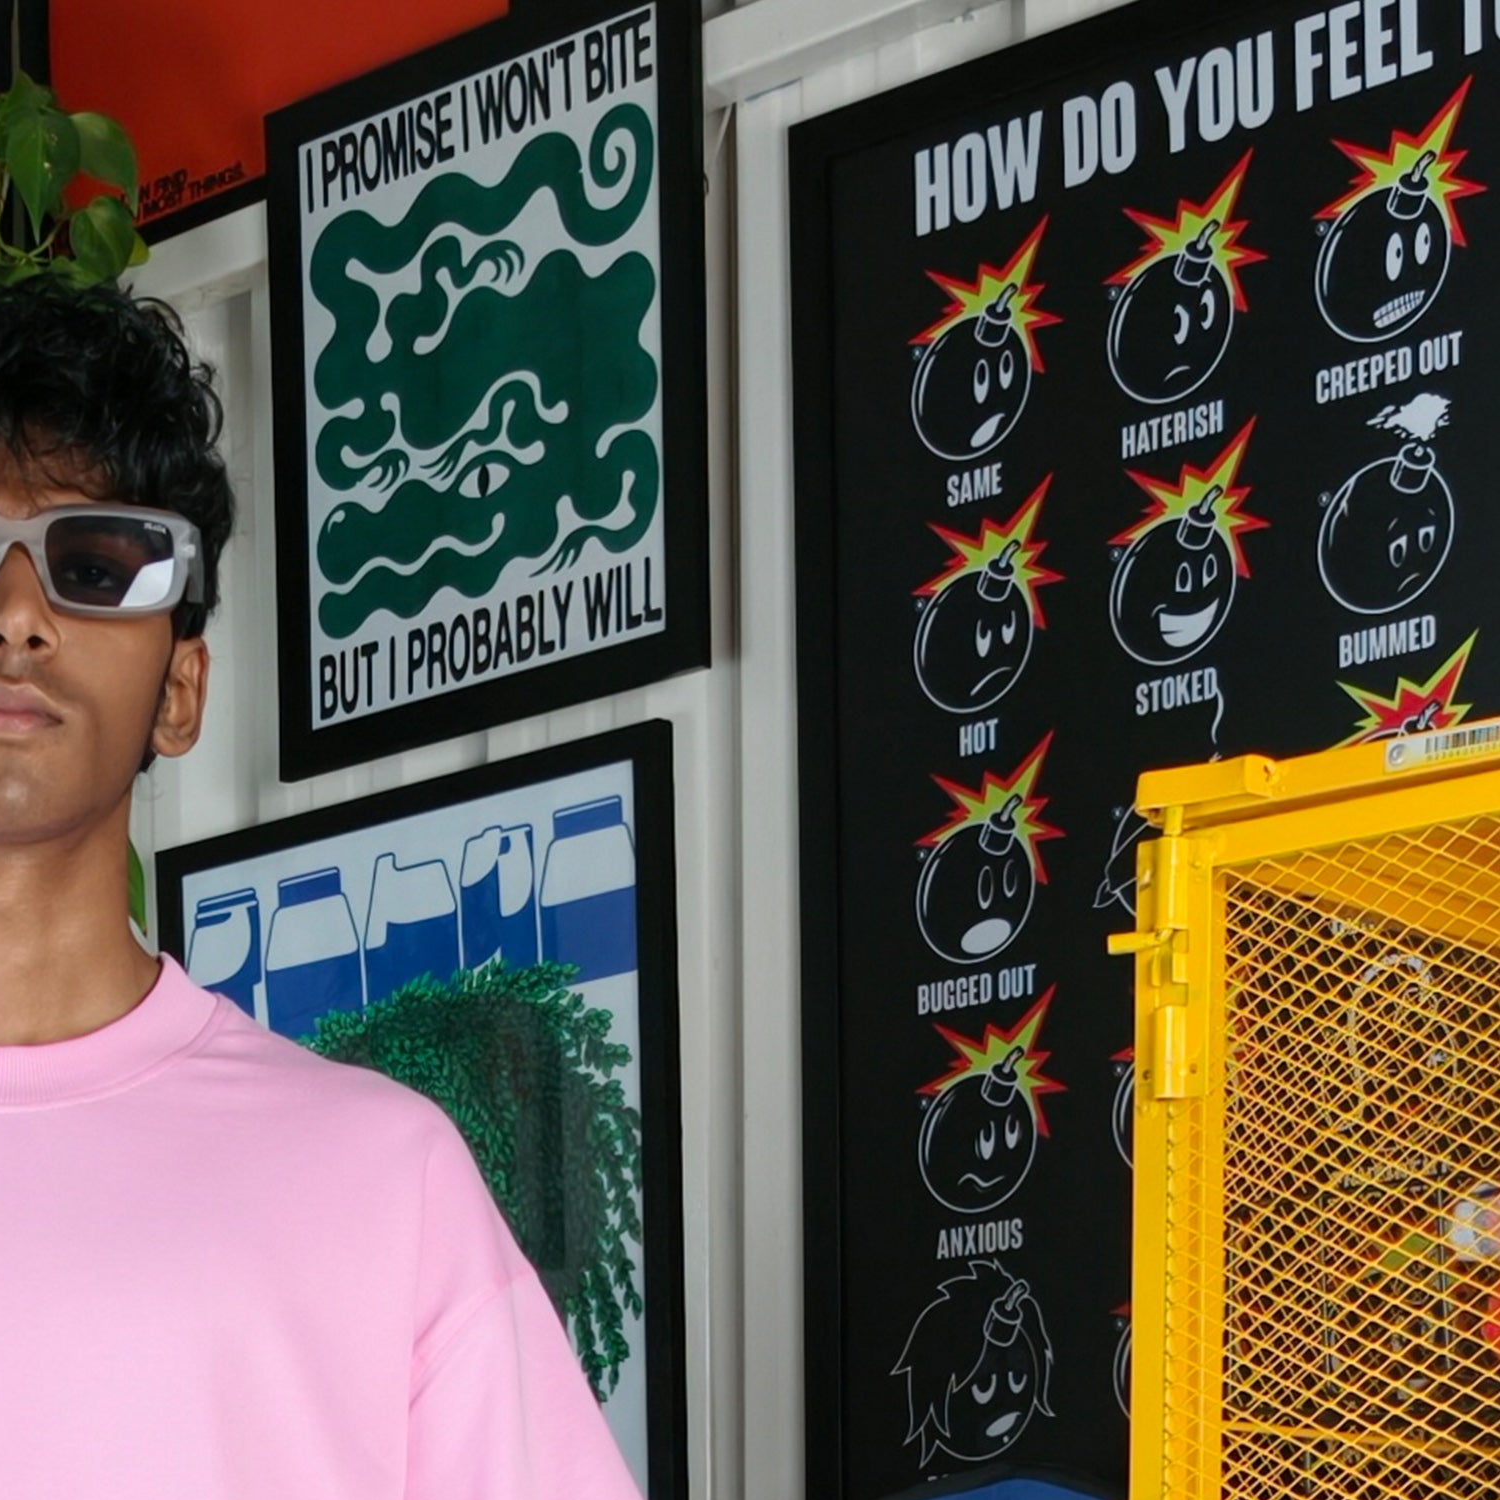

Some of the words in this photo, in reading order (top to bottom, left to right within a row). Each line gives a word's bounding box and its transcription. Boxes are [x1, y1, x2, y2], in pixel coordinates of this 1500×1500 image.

[305, 148, 315, 214] I
[321, 91, 456, 208] PROMISE
[460, 85, 470, 153] I
[474, 39, 577, 146] WON'T
[583, 7, 654, 104] BITE
[915, 110, 1043, 237] HOW
[1063, 81, 1137, 189] DO
[1154, 30, 1275, 154] YOU
[1294, 0, 1435, 114] FEEL
[1316, 346, 1412, 404] CREEPED
[1419, 330, 1463, 375] OUT
[1122, 400, 1224, 459] HATERISH
[947, 463, 1002, 507] SAME
[319, 641, 379, 721] BUT
[389, 635, 397, 701] I
[407, 580, 574, 696] PROBABLY
[583, 556, 663, 642] WILL
[1339, 614, 1436, 668] BUMMED
[1136, 667, 1218, 715] STOKED
[960, 718, 999, 756] HOT
[918, 973, 992, 1015] BUGGED
[999, 964, 1037, 1000] OUT
[937, 1218, 1023, 1259] ANXIOUS
